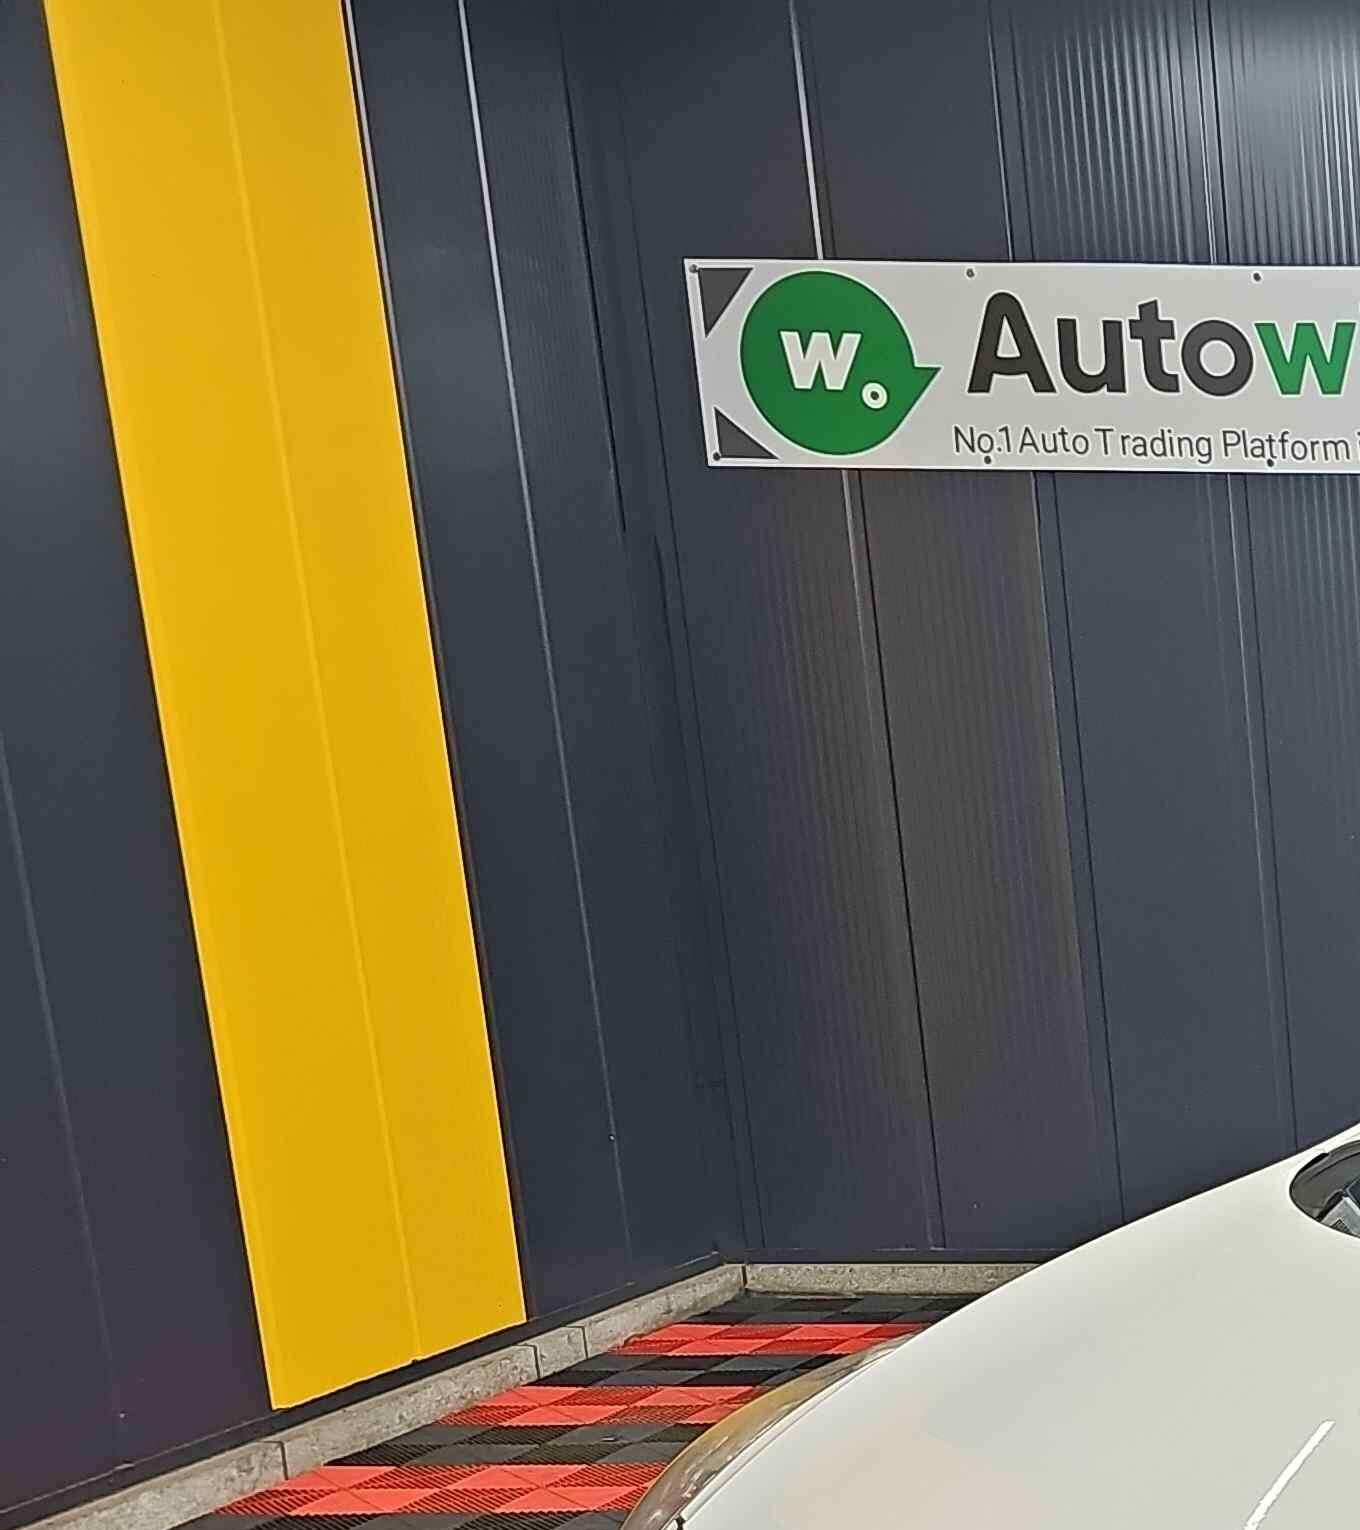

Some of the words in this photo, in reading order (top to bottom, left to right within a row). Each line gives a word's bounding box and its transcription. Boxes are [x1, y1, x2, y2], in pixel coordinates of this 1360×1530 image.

[1018, 427, 1089, 455] Auto
[1095, 428, 1212, 464] Trading
[1222, 430, 1350, 461] Platform
